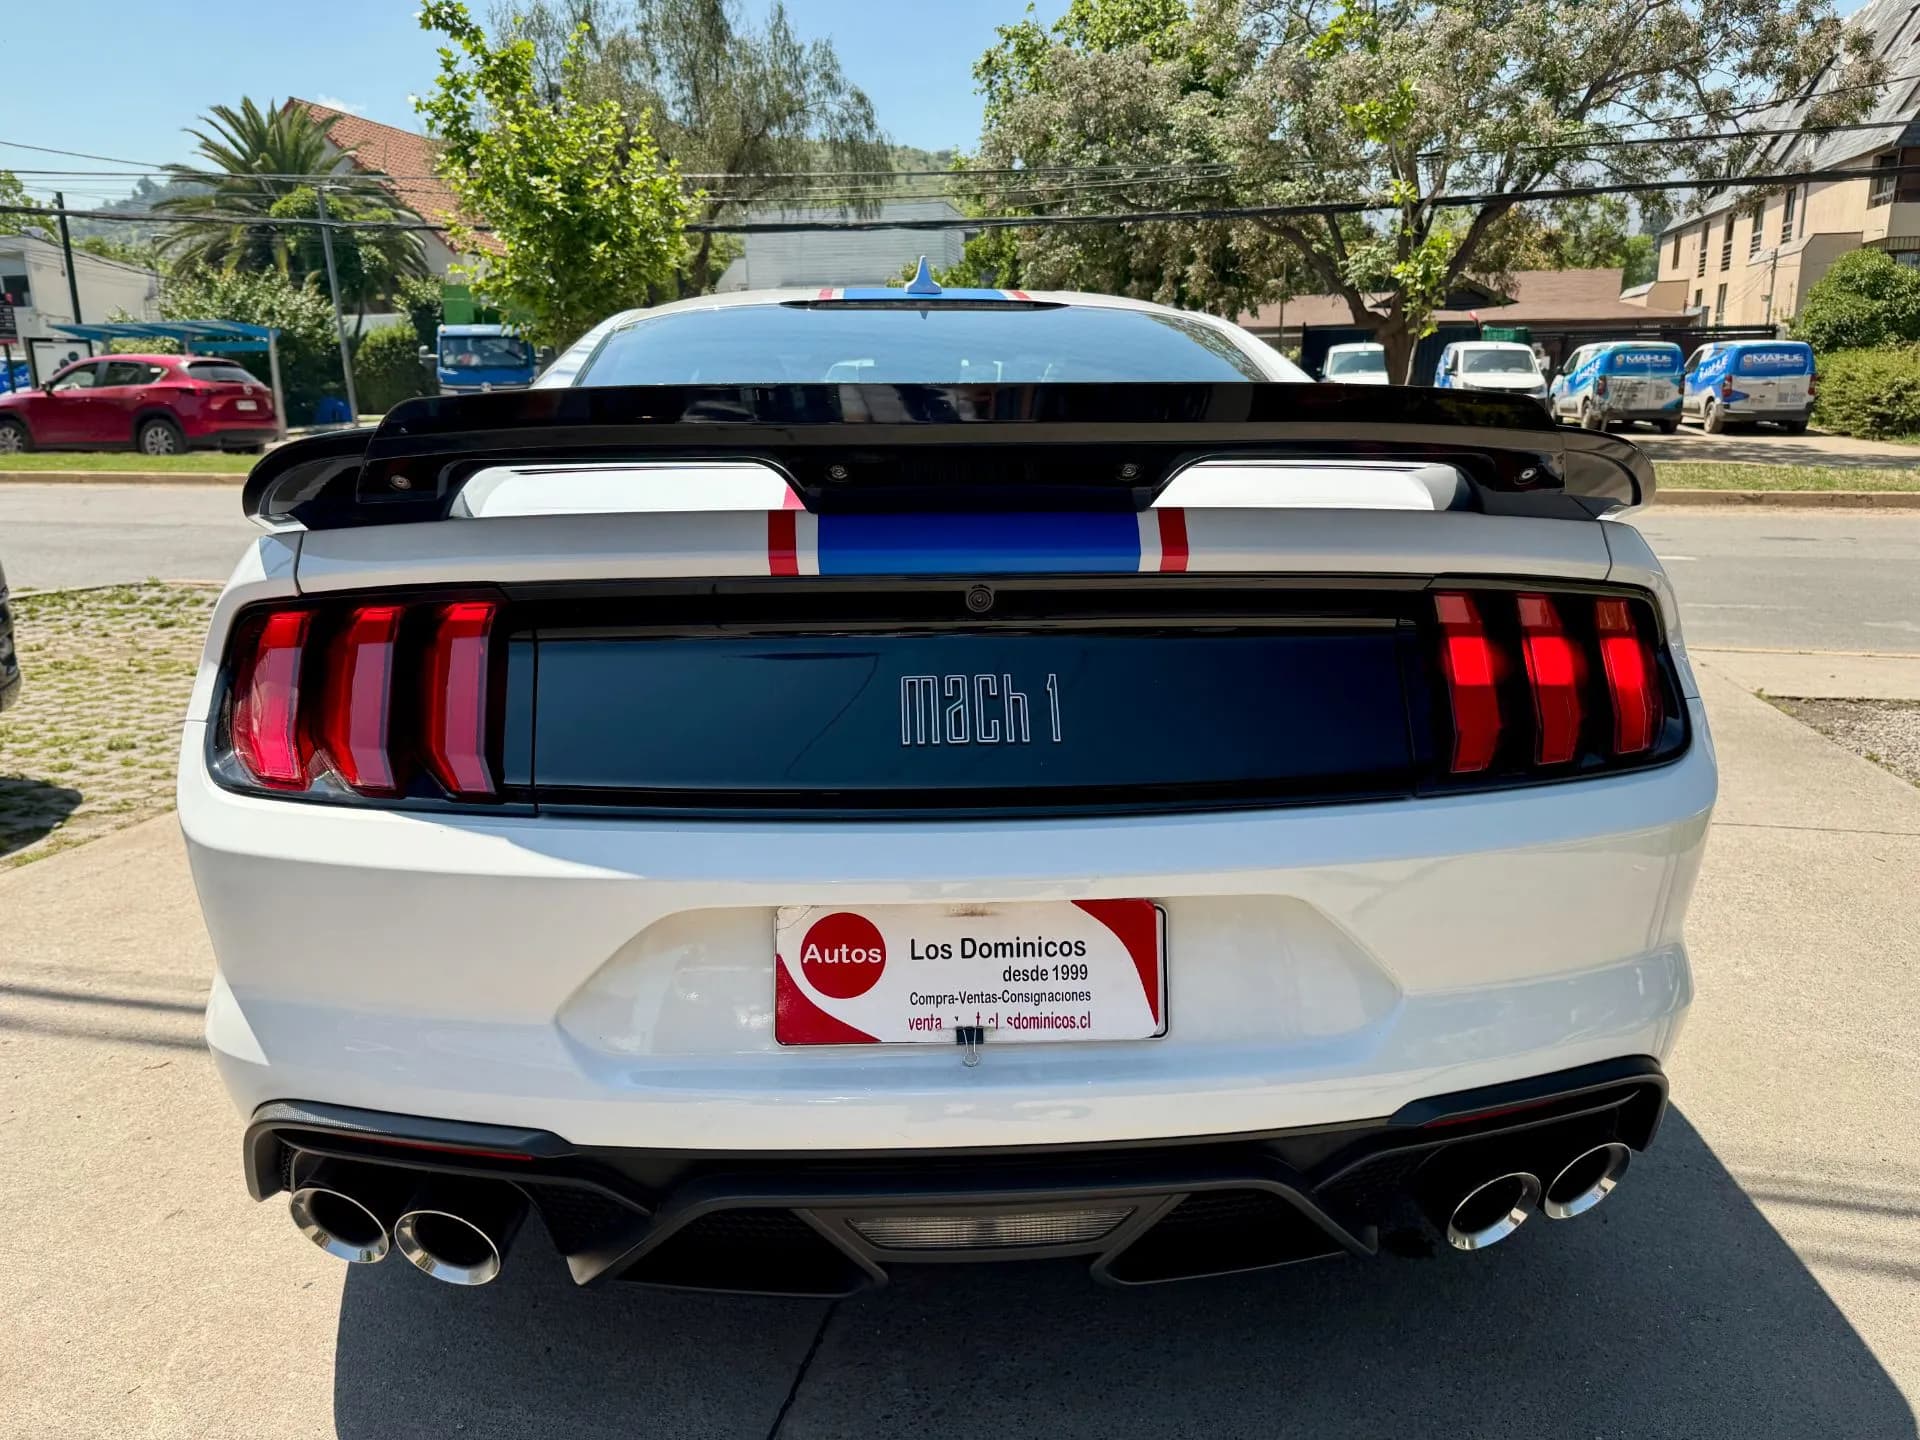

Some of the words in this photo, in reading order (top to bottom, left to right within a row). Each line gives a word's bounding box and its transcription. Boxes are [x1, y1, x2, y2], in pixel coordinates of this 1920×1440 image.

[1046, 673, 1062, 743] 1
[802, 943, 882, 964] Autos
[910, 938, 953, 961] Los
[960, 936, 1087, 960] Dominicos
[1002, 965, 1049, 982] desde
[1052, 964, 1088, 981] 1999
